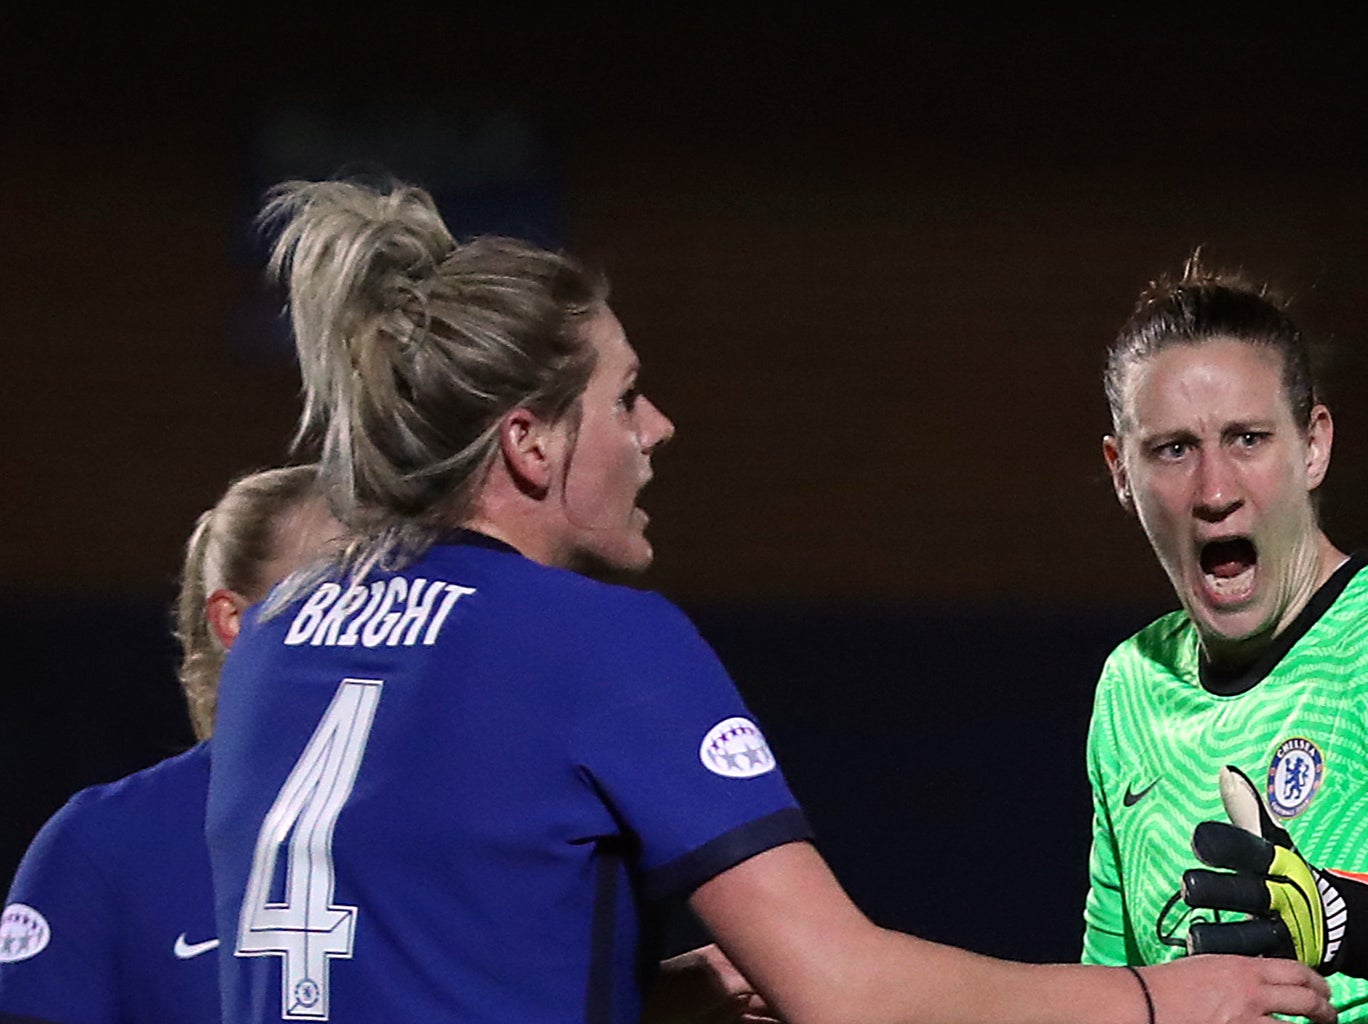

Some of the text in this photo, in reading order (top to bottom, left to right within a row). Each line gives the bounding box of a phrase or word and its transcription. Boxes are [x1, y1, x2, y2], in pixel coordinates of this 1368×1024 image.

[283, 575, 477, 647] BRIGHT
[1277, 739, 1316, 758] CHELSEA
[234, 678, 384, 1021] 4
